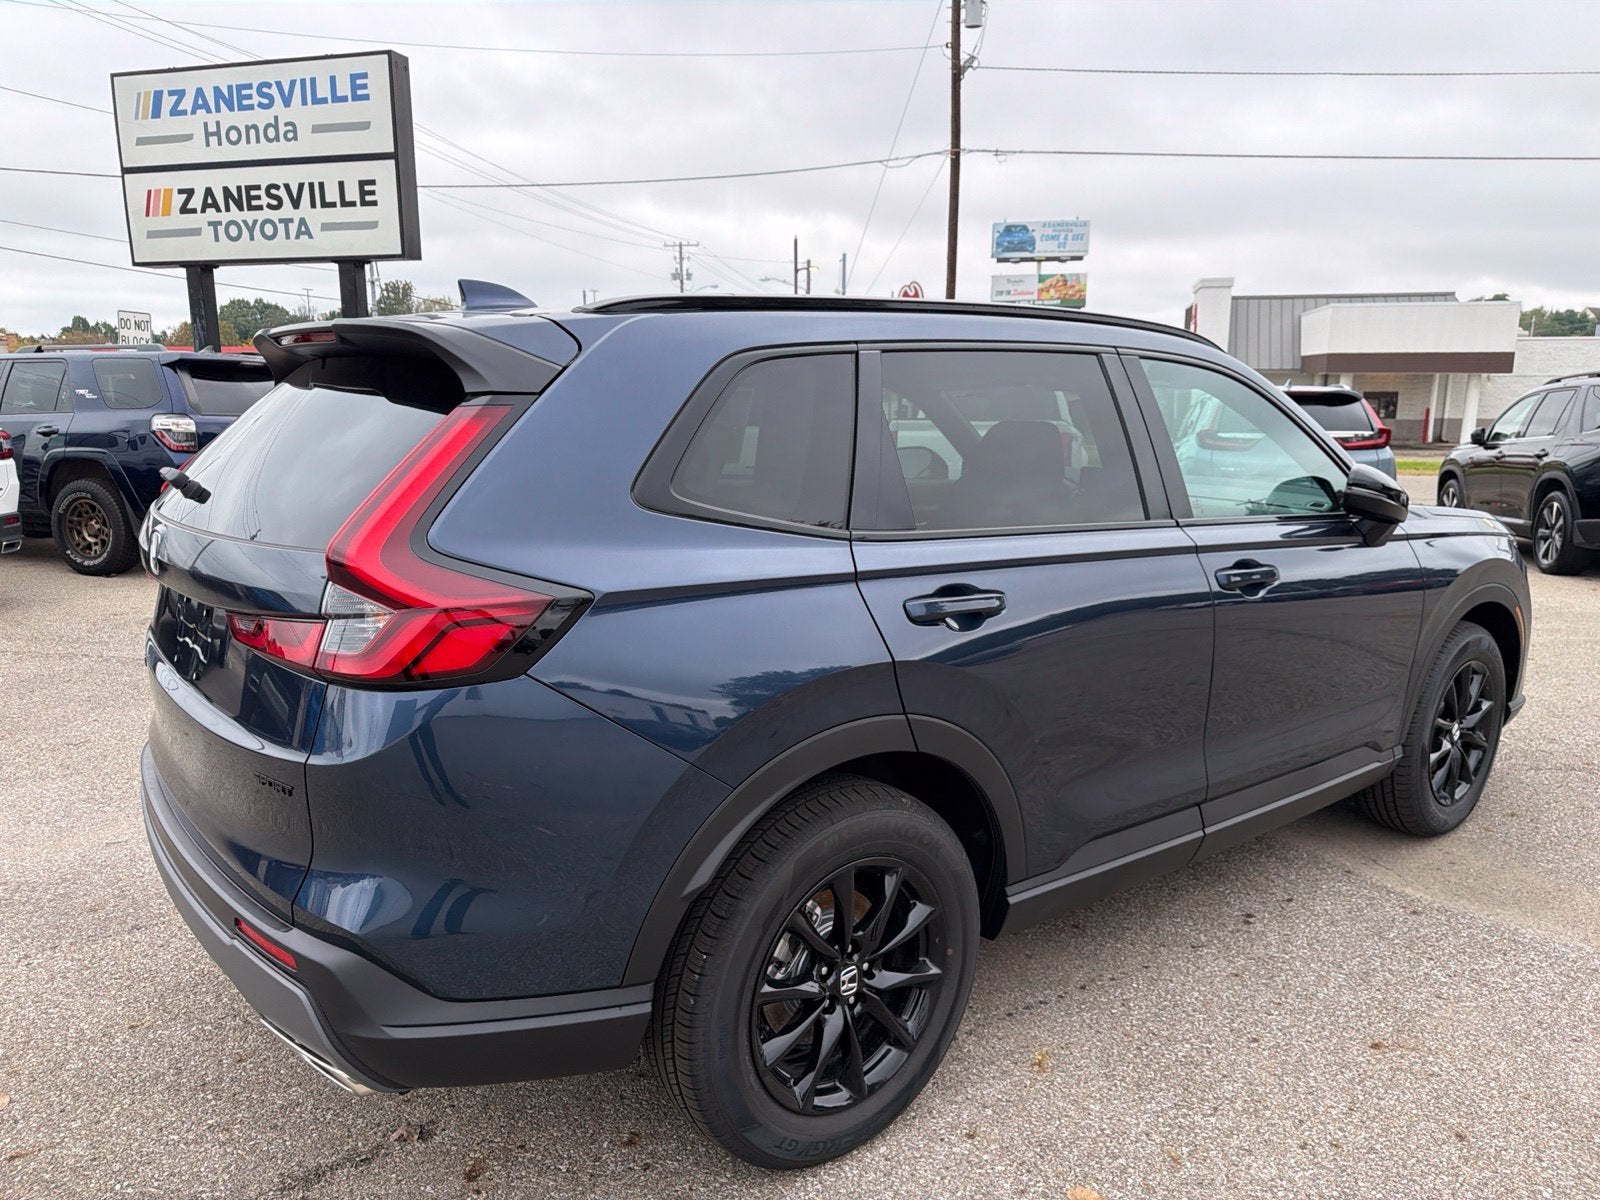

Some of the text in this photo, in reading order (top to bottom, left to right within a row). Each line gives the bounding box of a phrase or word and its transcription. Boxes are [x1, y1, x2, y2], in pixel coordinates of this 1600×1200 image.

[167, 72, 371, 117] ZANESVILLE
[203, 115, 298, 147] Honda
[177, 179, 378, 215] ZANESVILLE
[207, 216, 314, 242] TOYOTA
[120, 317, 150, 332] DO NOT
